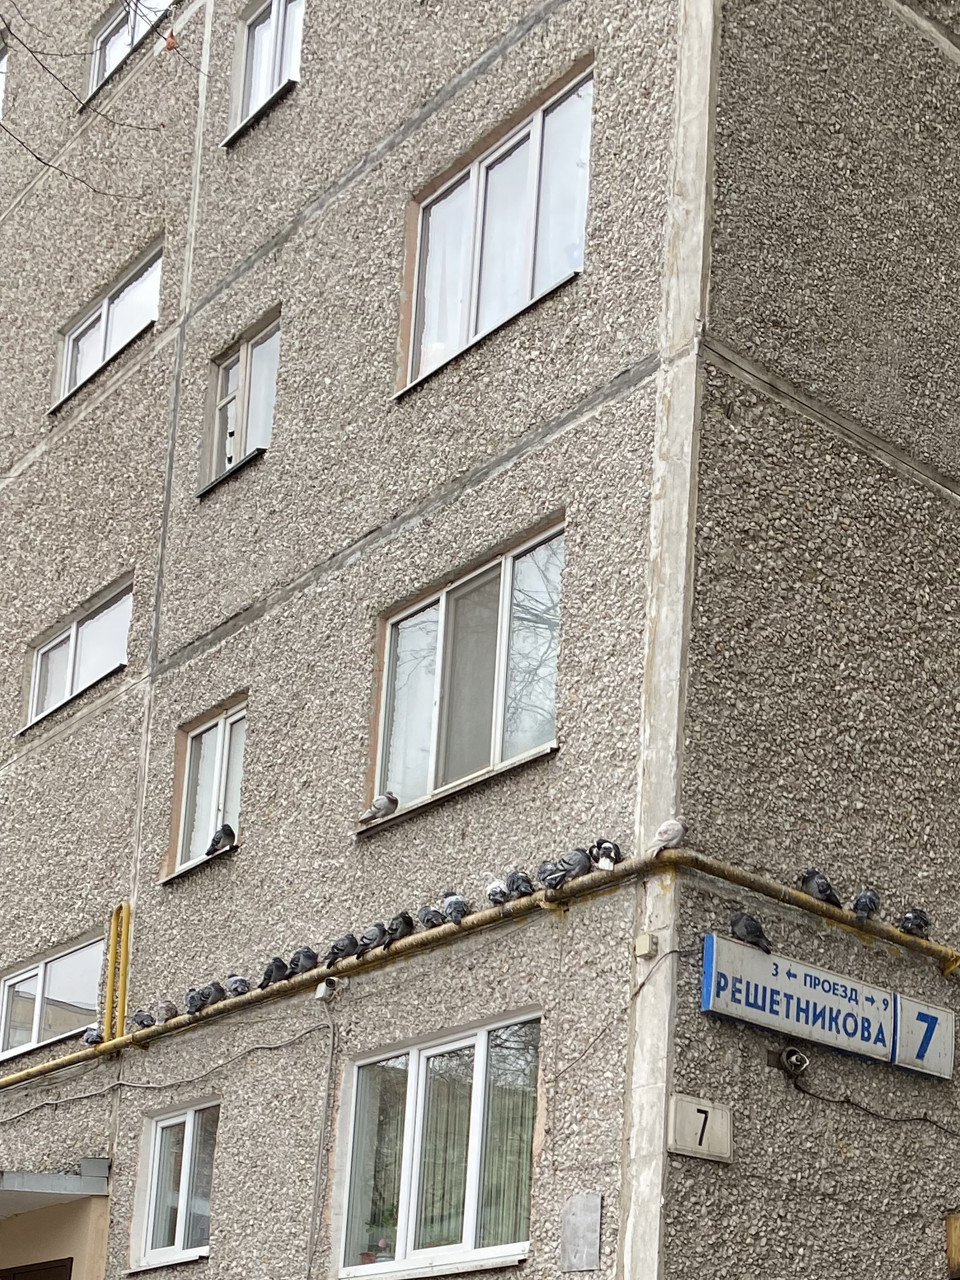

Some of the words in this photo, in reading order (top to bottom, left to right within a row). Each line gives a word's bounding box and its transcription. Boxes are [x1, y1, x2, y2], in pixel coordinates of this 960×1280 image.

[715, 970, 887, 1048] РЕШЕТНИКОВА
[771, 962, 779, 977] 3
[803, 973, 859, 1006] ПРОЕЗД
[882, 998, 890, 1012] 9
[915, 1011, 939, 1061] 7
[696, 1108, 709, 1147] 7
